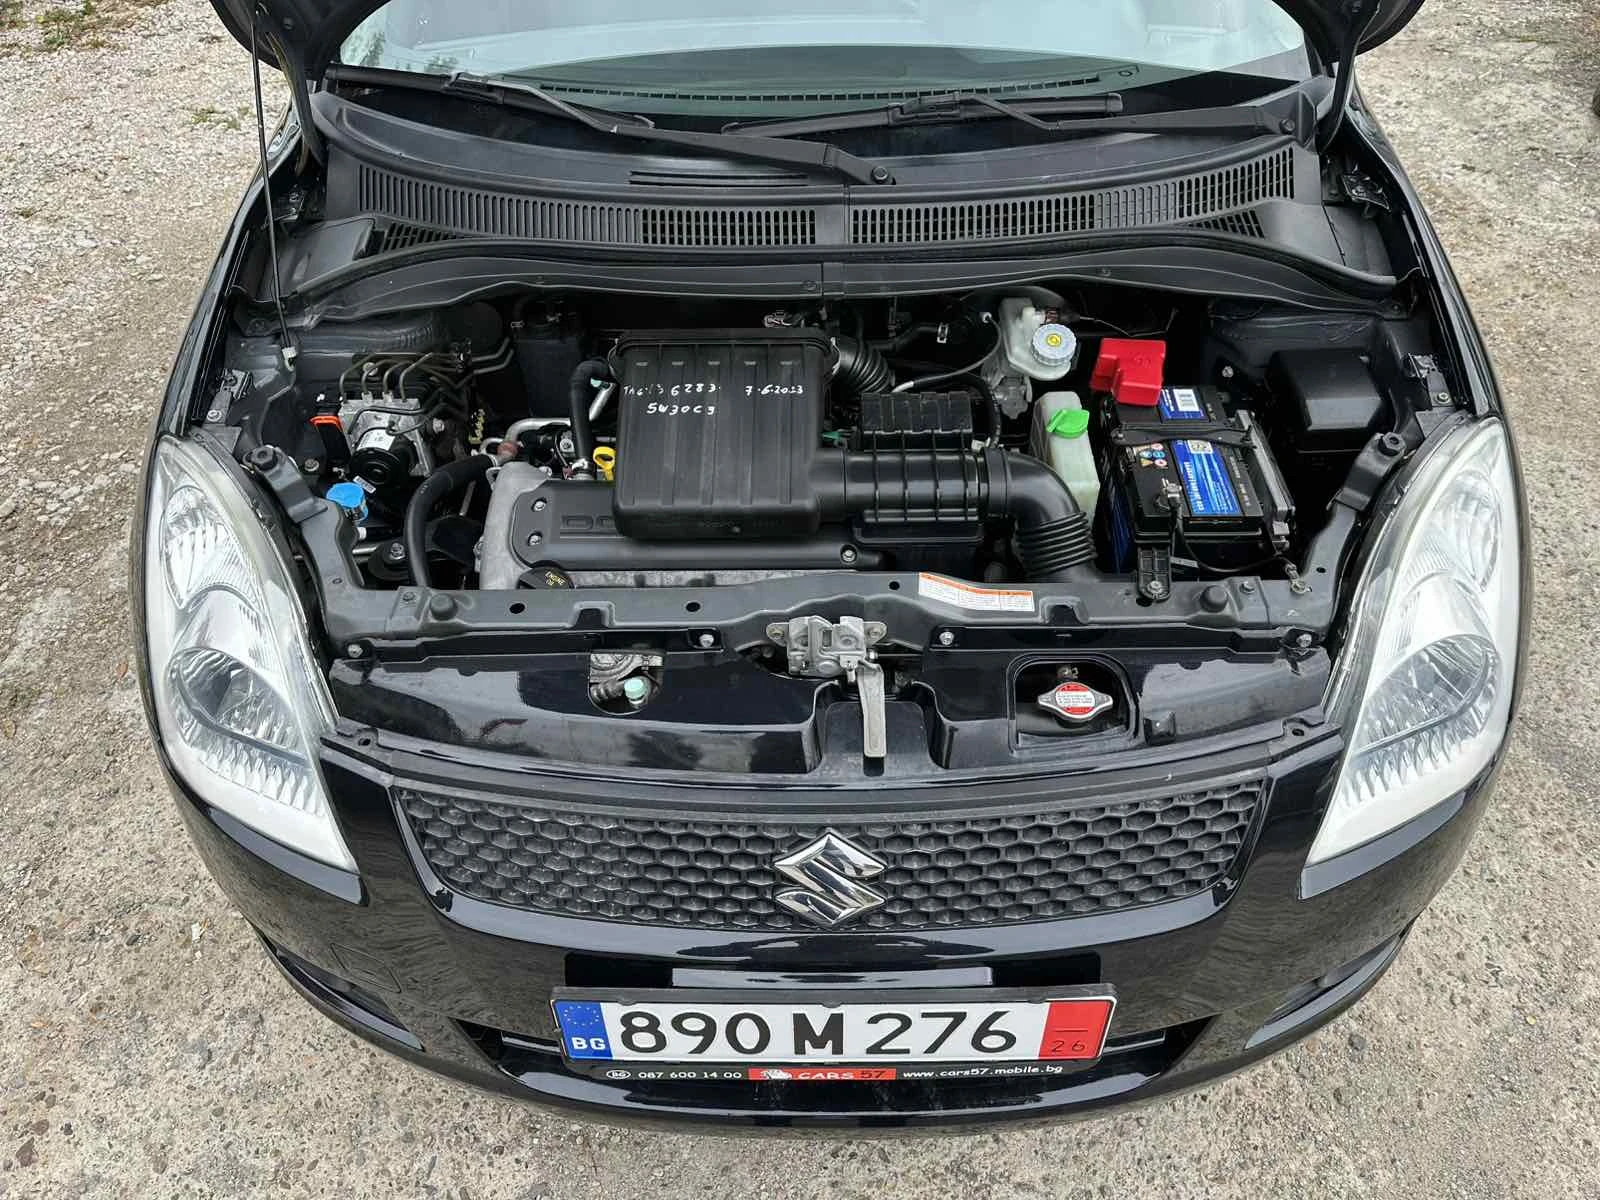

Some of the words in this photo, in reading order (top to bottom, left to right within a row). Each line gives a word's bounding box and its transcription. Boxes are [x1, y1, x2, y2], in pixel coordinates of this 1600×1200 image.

[619, 1010, 771, 1055] 890
[792, 1012, 844, 1056] M
[865, 1010, 1017, 1055] 276
[571, 1036, 606, 1051] BG
[1051, 1040, 1086, 1053] 26
[638, 1071, 664, 1079] 087
[670, 1071, 697, 1079] 600
[703, 1071, 718, 1079] 14
[723, 1071, 742, 1079] 00
[798, 1071, 854, 1080] CARS
[860, 1070, 886, 1079] 57
[903, 1065, 1064, 1078] www.cars57.mobile.bg
